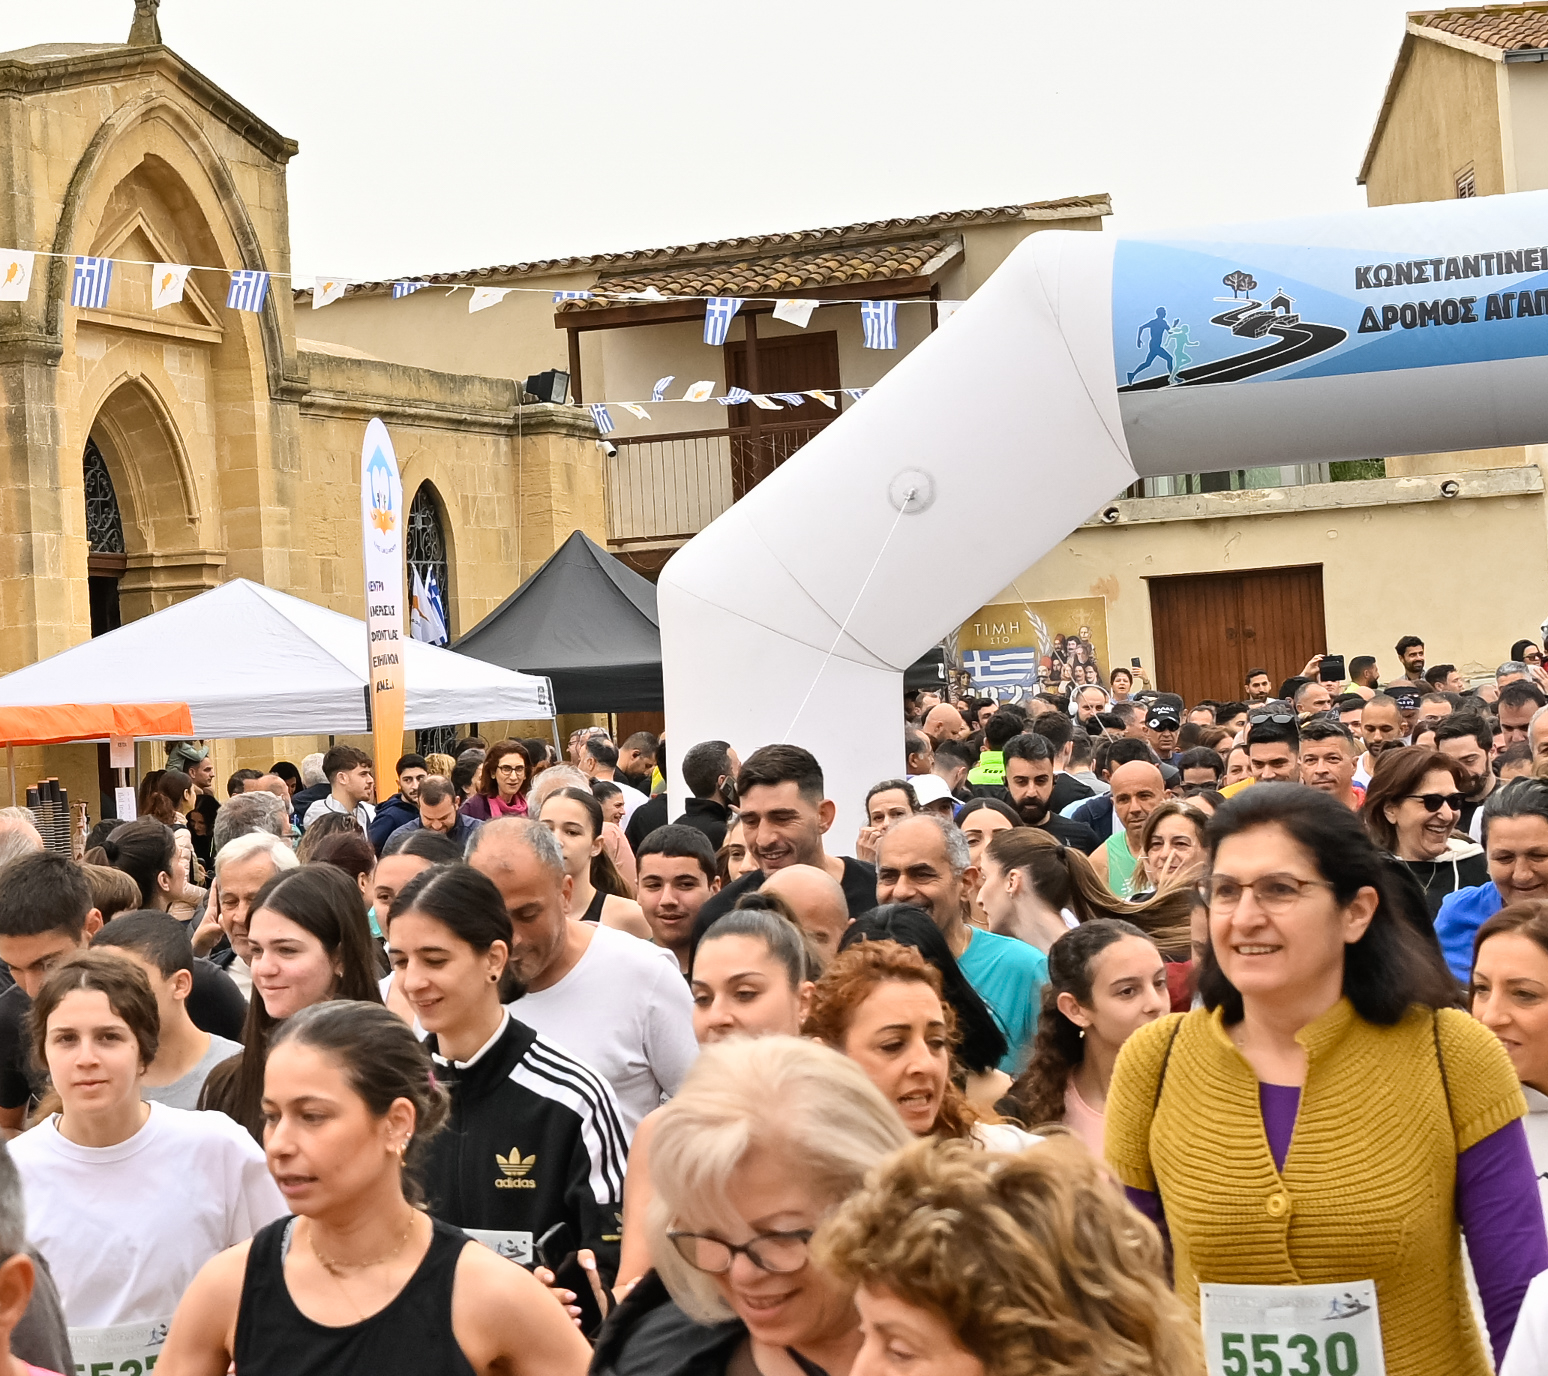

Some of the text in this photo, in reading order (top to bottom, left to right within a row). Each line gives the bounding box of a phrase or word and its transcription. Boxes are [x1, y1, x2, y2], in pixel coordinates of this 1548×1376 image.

[1357, 296, 1479, 334] ΔΡΟΜΟΣ
[973, 622, 1020, 636] ΤΙΜΗ
[990, 637, 1010, 645] ΣΤΟ
[494, 1177, 536, 1189] adidas
